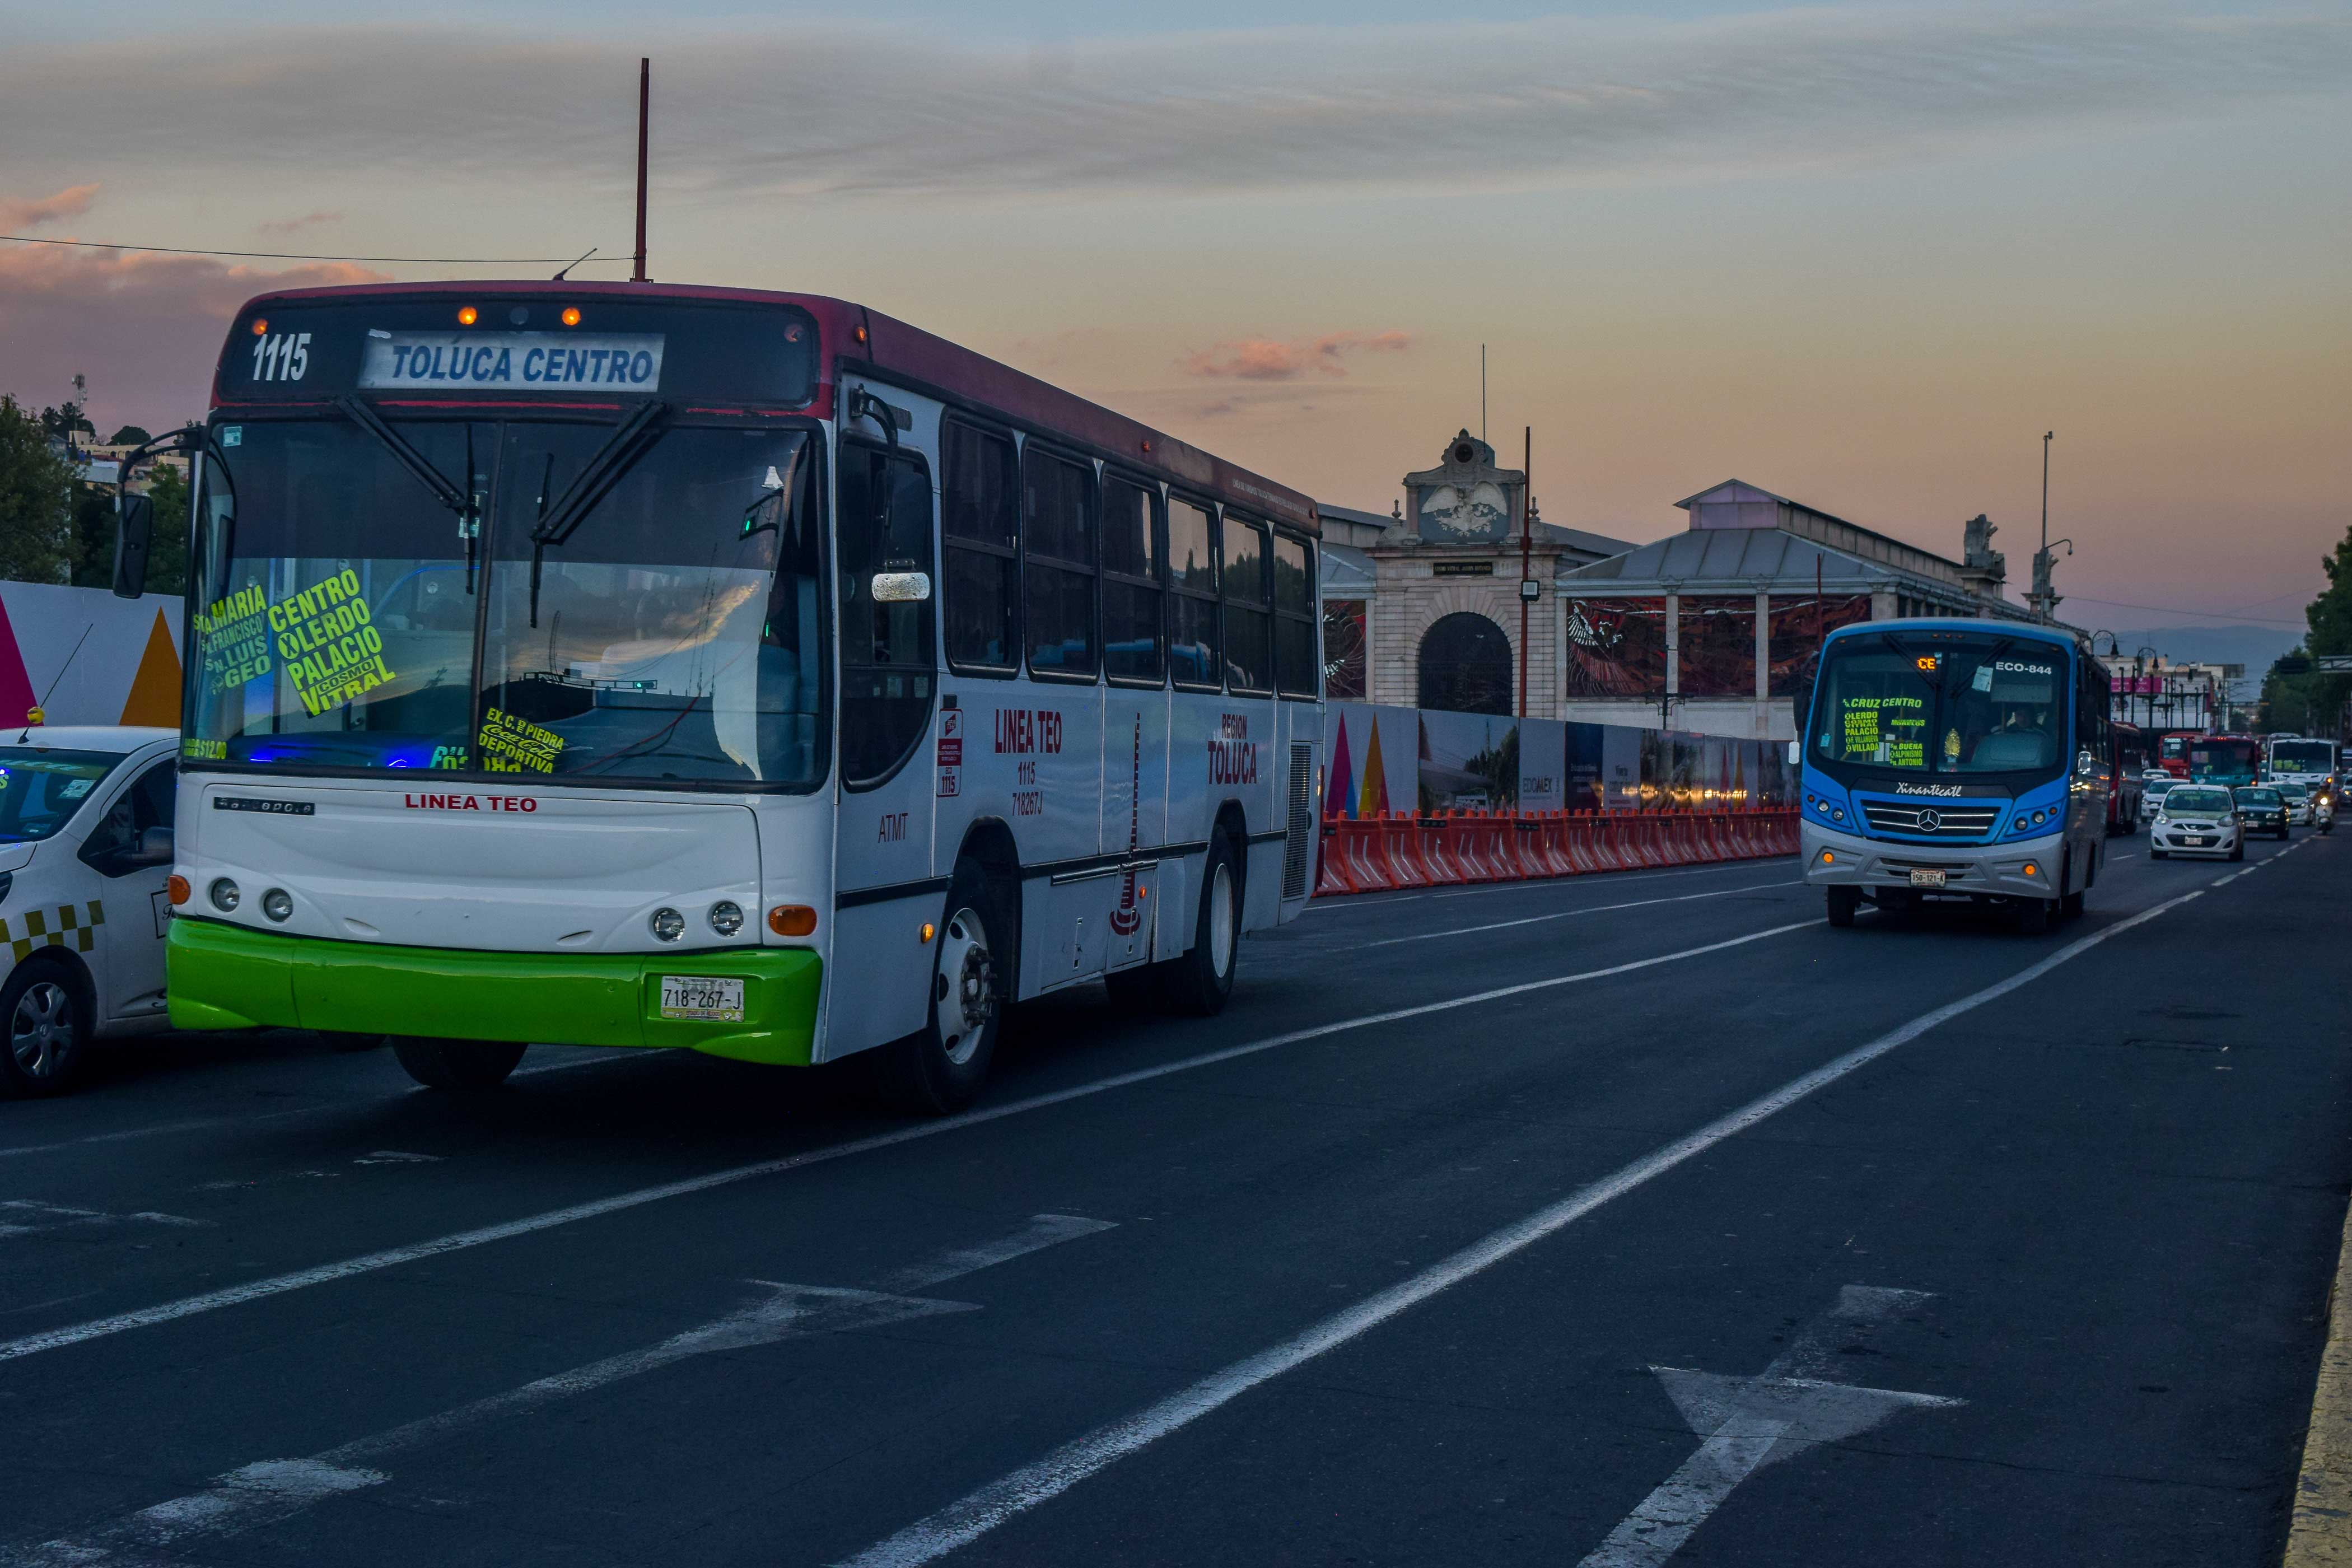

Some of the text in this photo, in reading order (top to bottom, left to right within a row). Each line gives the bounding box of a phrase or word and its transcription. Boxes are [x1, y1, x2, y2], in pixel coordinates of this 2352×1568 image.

[253, 333, 311, 381] 1115
[393, 345, 654, 383] TOLUCA CENTRO
[211, 585, 267, 631] MARIA
[268, 569, 360, 632] CENTRO
[295, 598, 371, 652] LERDO
[225, 635, 268, 667] LUIS
[286, 626, 383, 691] PALACIO
[225, 655, 271, 688] GEO
[319, 662, 373, 692] COSMO
[1996, 661, 2052, 675] ECO-844
[1851, 698, 1880, 708] CRUZ
[1882, 698, 1922, 708] CENTRO
[525, 724, 563, 750] PIEDRA
[995, 709, 1062, 754] LINEA TEO
[1222, 713, 1248, 739] REGION
[1845, 727, 1878, 736] PALACIO
[479, 732, 553, 773] DEPORTIVA
[1208, 740, 1257, 785] TOLUCA
[1852, 743, 1879, 752] VILLADA
[941, 776, 955, 793] 1115
[1018, 761, 1035, 785] 1115
[405, 794, 537, 812] LINEA TEO
[1012, 791, 1043, 816] 718267J
[878, 813, 908, 843] ATMT
[664, 989, 740, 1009] 718-267-J
